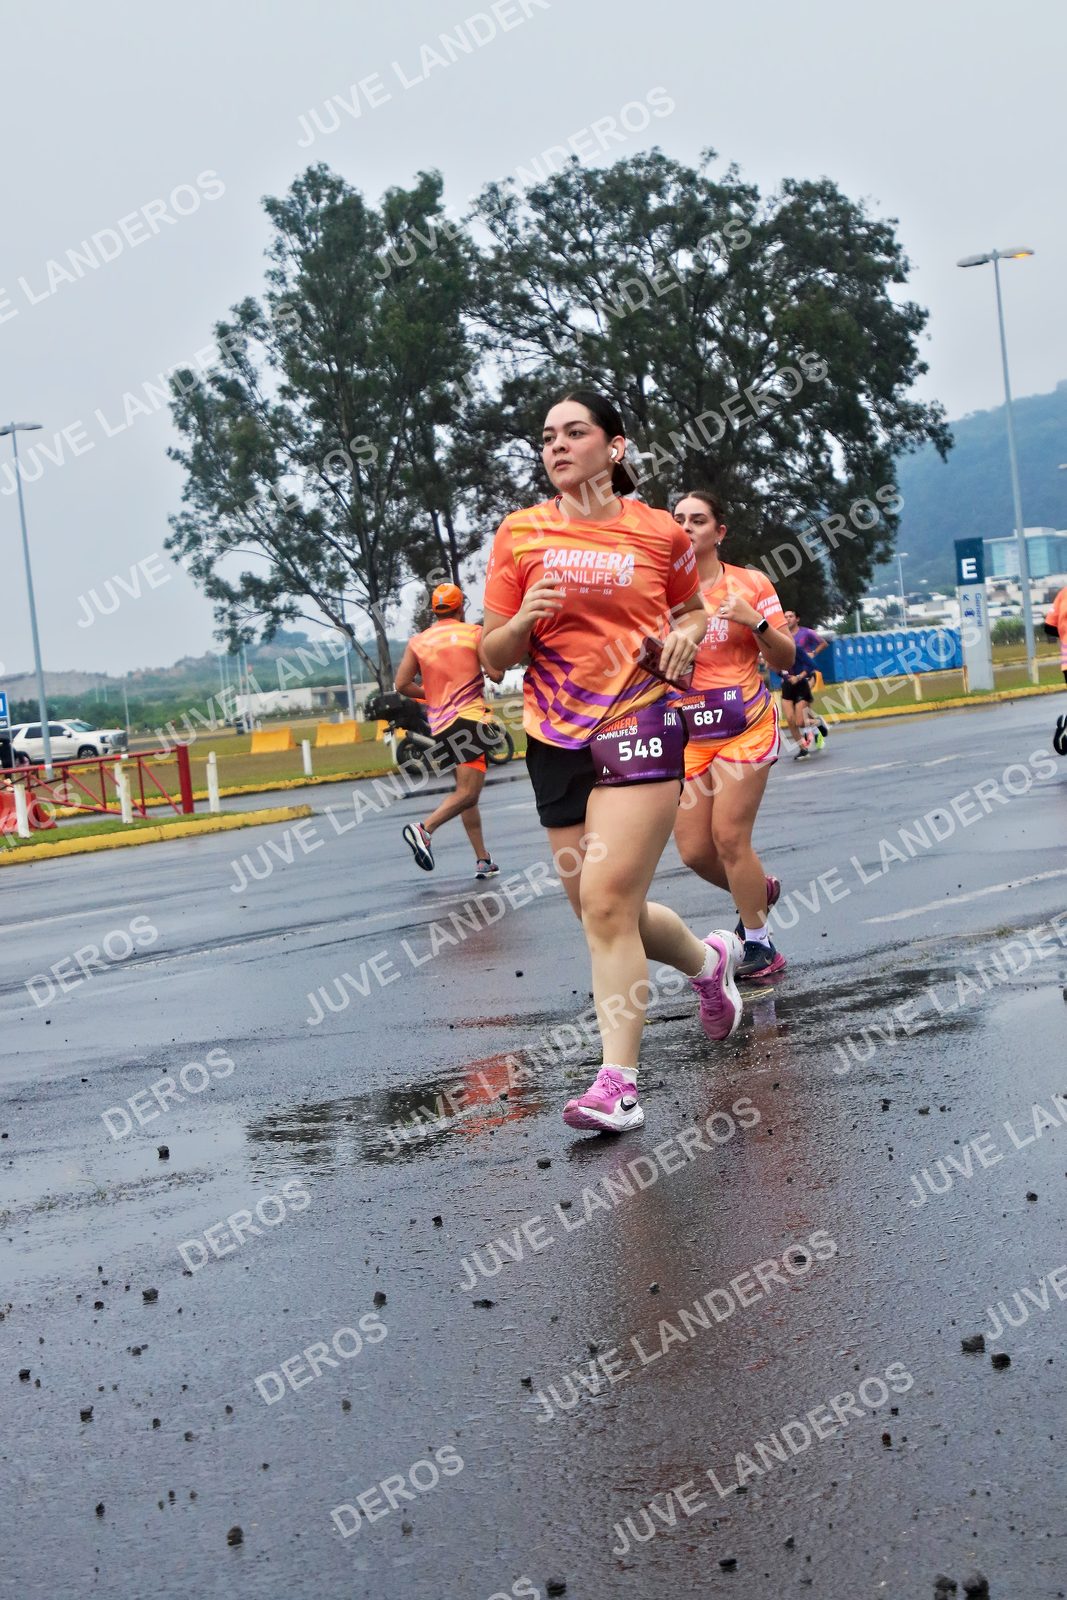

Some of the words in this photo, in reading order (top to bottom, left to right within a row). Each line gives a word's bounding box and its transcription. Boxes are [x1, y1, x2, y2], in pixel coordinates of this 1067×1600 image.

[542, 548, 636, 571] CARRERA
[962, 558, 978, 580] E
[543, 570, 612, 585] OMNILIFE
[694, 708, 722, 726] 687
[596, 729, 628, 740] OMNILIFE
[618, 737, 663, 762] 548
